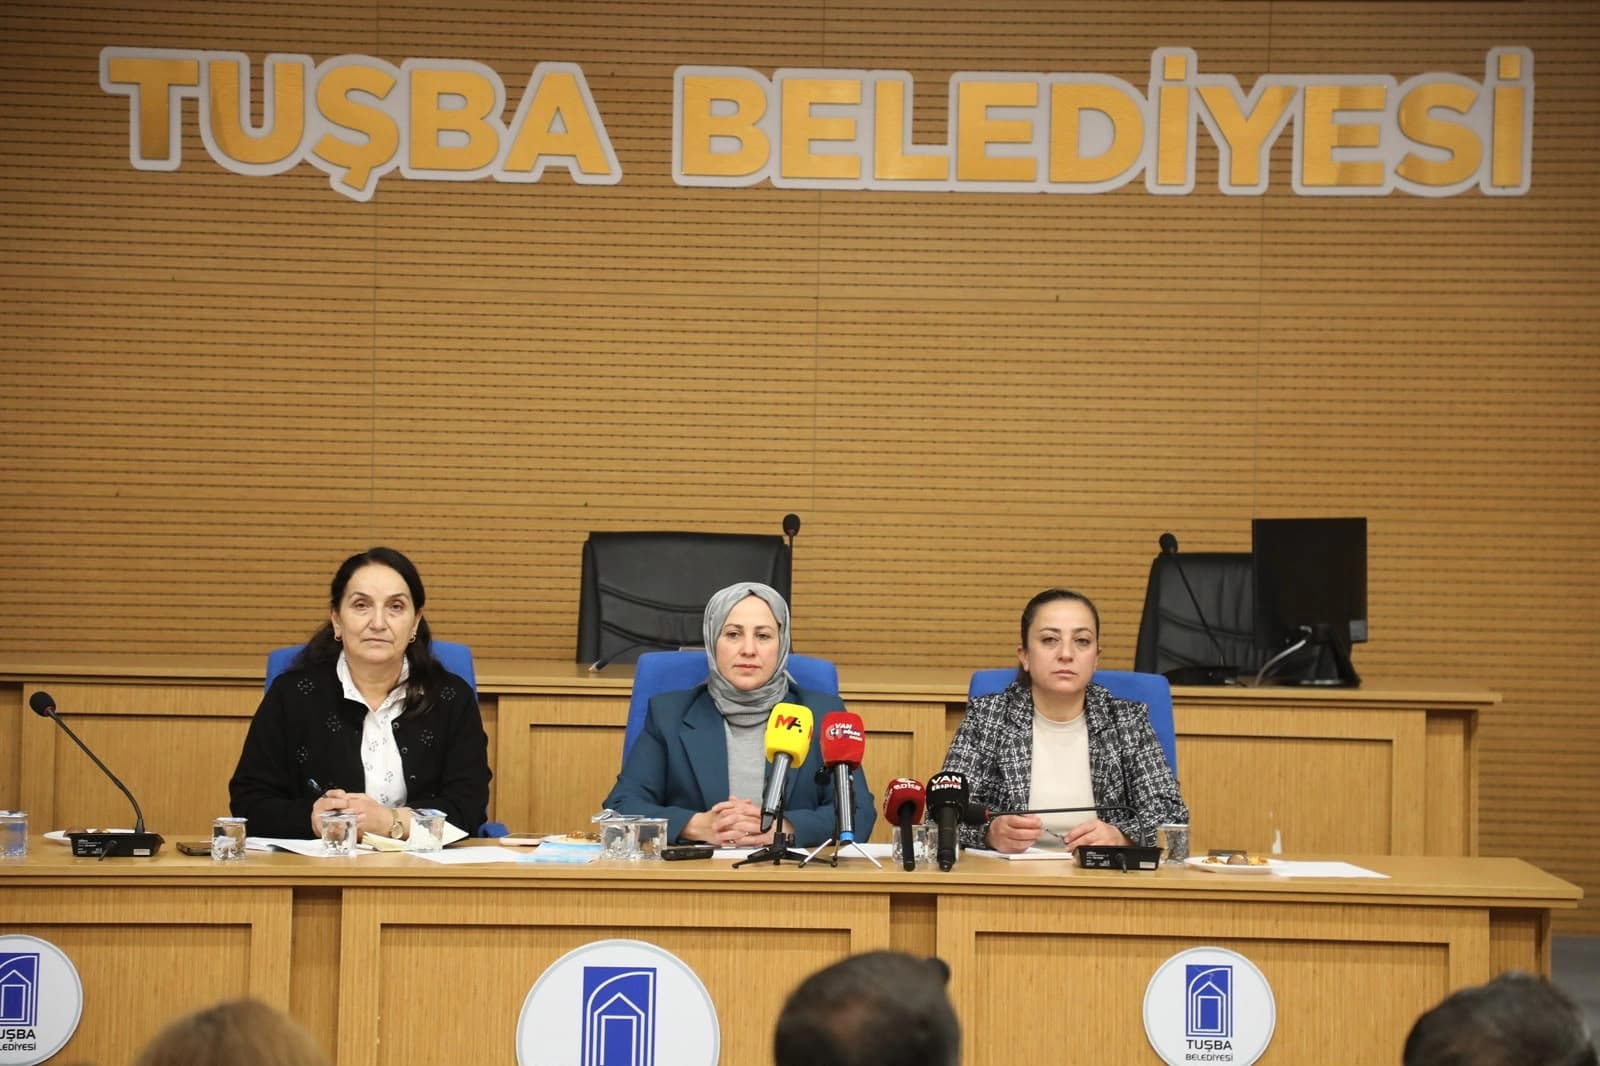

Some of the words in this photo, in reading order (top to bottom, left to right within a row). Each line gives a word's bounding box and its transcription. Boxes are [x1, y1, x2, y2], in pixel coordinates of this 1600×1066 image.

[101, 48, 621, 200] TUŞBA
[674, 47, 1533, 196] BELEDİYESİ
[932, 775, 962, 784] VAN
[0, 1029, 36, 1042] UŞBA
[0, 1042, 36, 1051] EDİYESİ
[1186, 1039, 1232, 1053] TUŞBA
[1185, 1052, 1233, 1062] BELEDİYESİ
